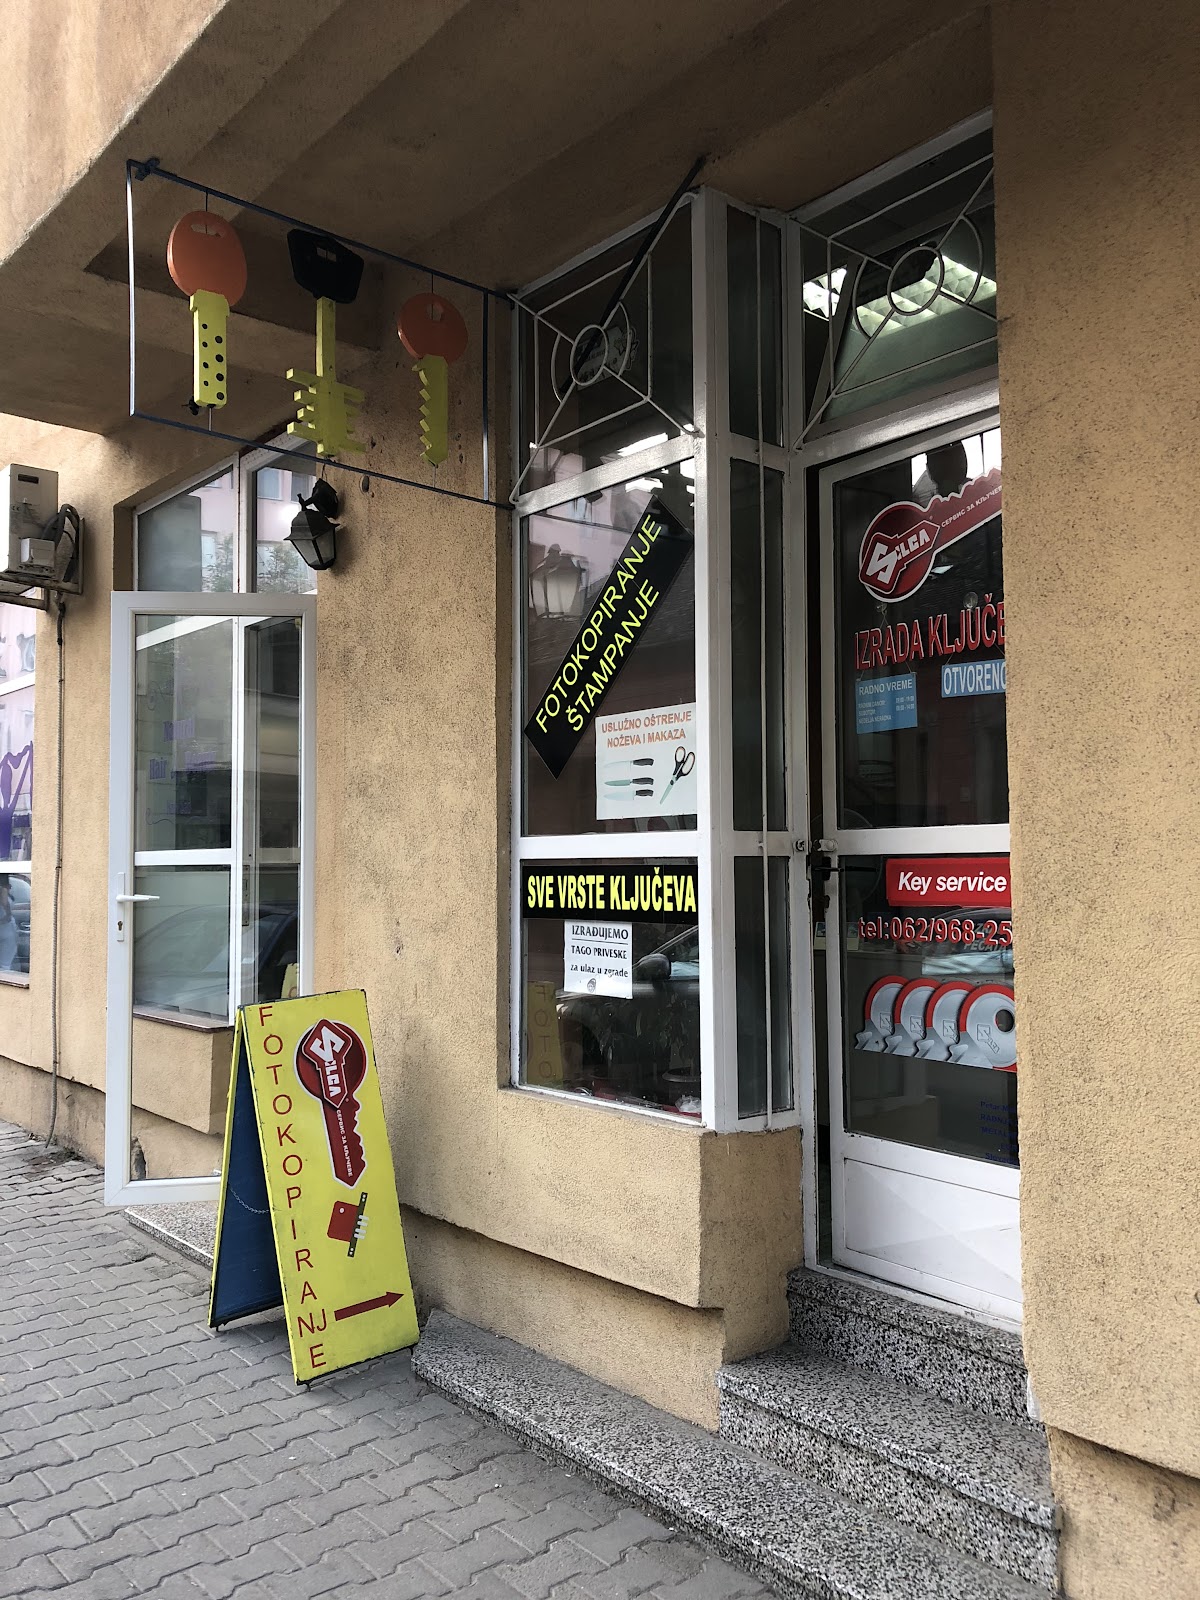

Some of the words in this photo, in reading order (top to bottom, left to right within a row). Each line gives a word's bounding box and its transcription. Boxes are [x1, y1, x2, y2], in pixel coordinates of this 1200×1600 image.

[941, 509, 966, 527] СЕРВИС
[865, 528, 931, 585] SILCA
[535, 514, 662, 734] FOTOKOPIRANJE
[565, 578, 660, 732] ŠTAMPANJE
[854, 619, 925, 671] IZRADA
[859, 683, 885, 696] RADNO
[886, 679, 913, 692] VREME
[601, 717, 642, 734] USLUŽNO
[643, 711, 692, 728] OŠTRENJE
[607, 734, 642, 749] NOŽEVA
[643, 734, 646, 744] I
[647, 728, 687, 743] MAKAZA
[527, 875, 554, 909] SVE
[557, 874, 606, 910] VRSTE
[609, 866, 697, 913] KLJUČEVA
[898, 871, 932, 896] Key
[935, 871, 1008, 892] service
[572, 924, 629, 941] IZRAĐUJEMO
[571, 945, 592, 956] TAGO
[593, 948, 628, 960] PRIVESKE
[570, 964, 578, 972] za
[580, 963, 596, 974] ulaz
[603, 966, 629, 978] zgrade
[309, 1025, 345, 1098] SILCA
[259, 1005, 327, 1370] FOTOKOPIRANJE
